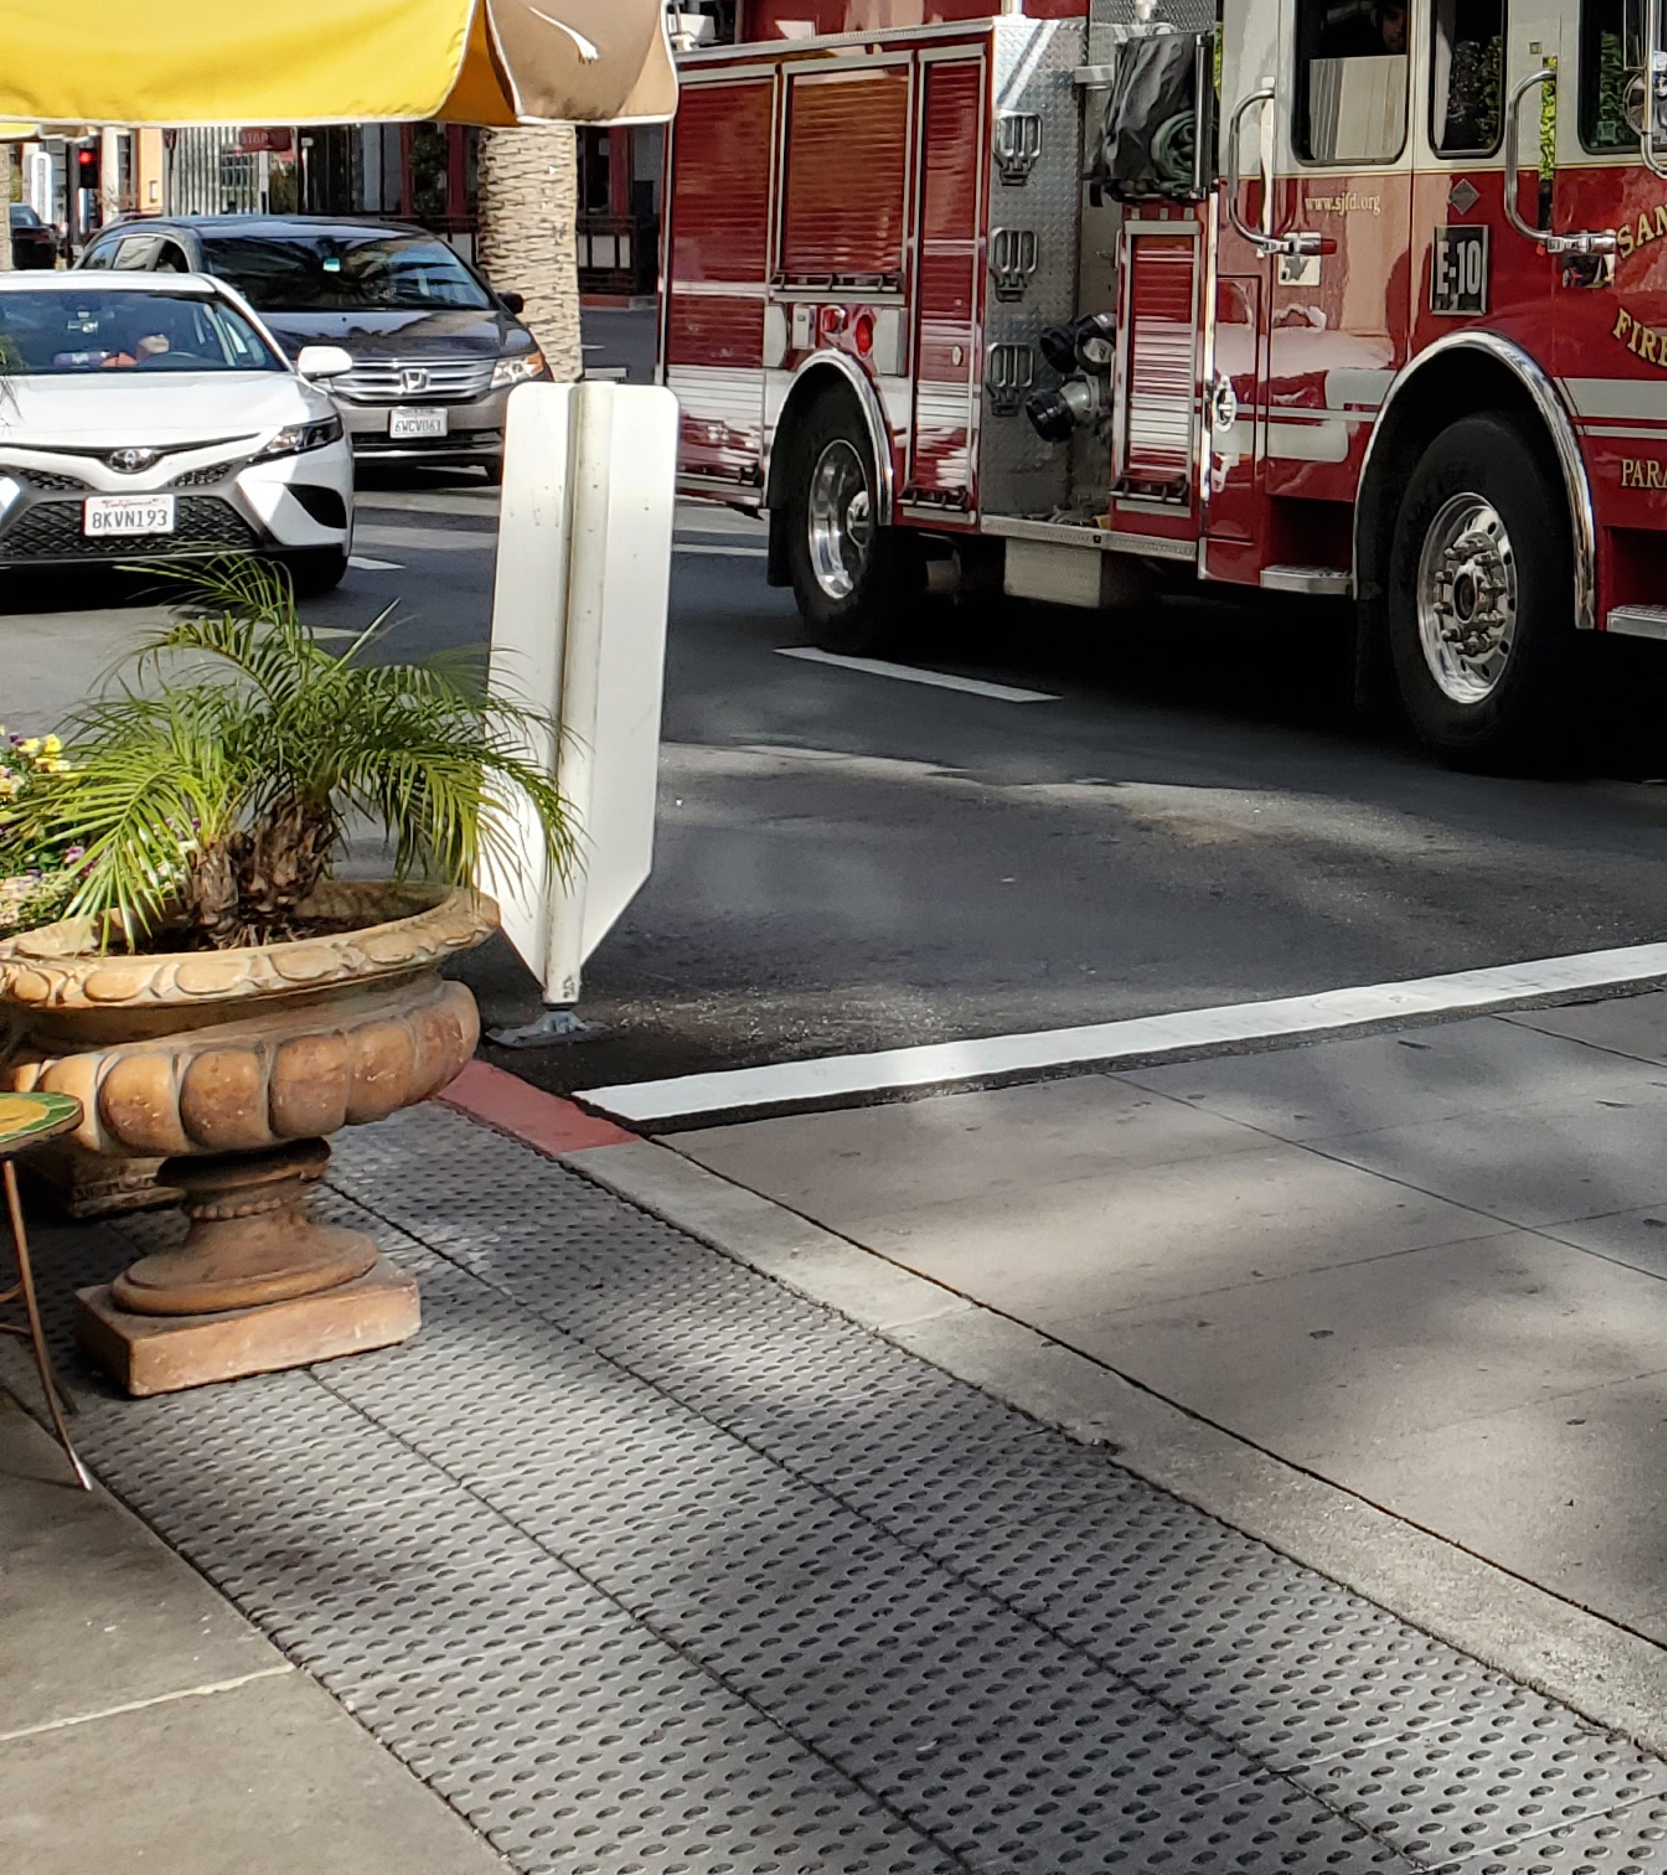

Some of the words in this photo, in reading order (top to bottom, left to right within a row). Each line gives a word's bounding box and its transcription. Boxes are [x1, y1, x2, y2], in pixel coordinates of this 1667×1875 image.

[241, 133, 269, 144] STOP
[1304, 193, 1381, 216] www.sjfd.org
[1435, 239, 1482, 295] E-10
[92, 509, 168, 530] 8KVN193
